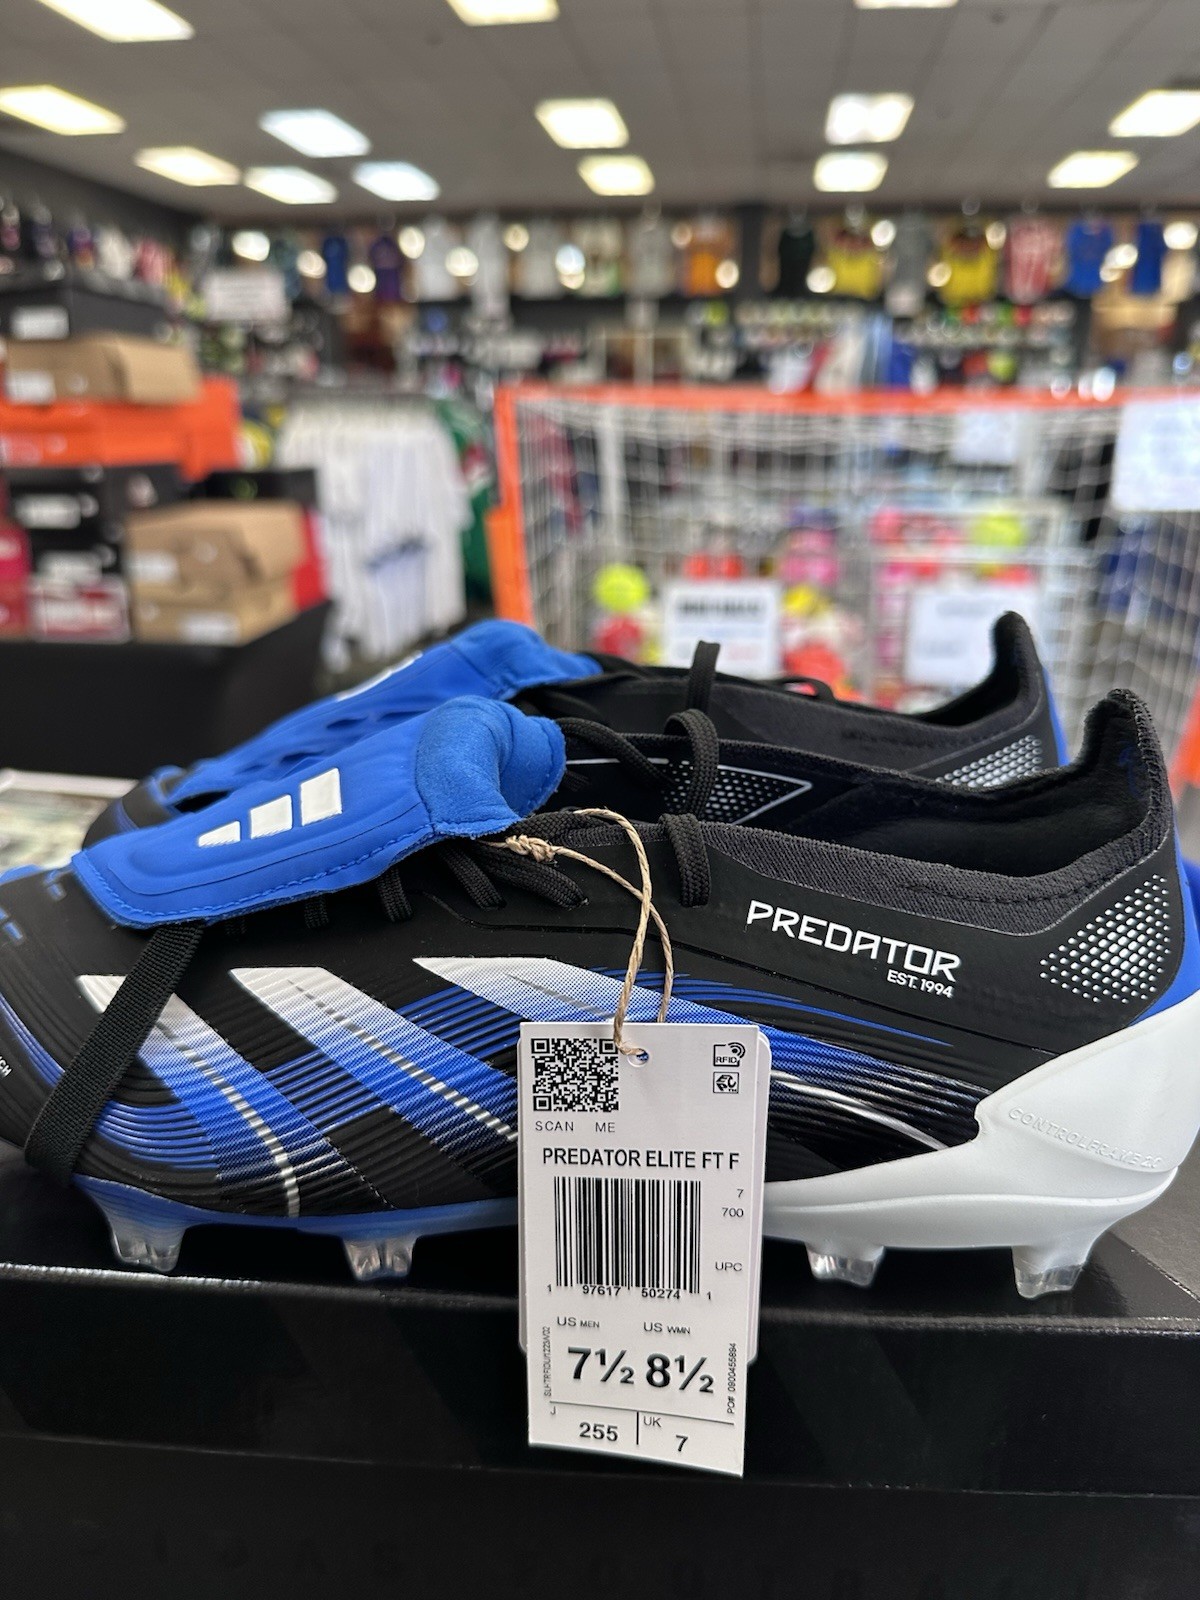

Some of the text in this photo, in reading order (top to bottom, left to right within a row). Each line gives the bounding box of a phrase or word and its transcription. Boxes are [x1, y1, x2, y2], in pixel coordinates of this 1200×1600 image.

[745, 899, 962, 984] PREDATOR
[886, 969, 954, 999] EST. 1994
[534, 1120, 616, 1133] SCAN ME
[542, 1147, 740, 1170] PREDATOR ELITE FT F
[736, 1189, 744, 1198] 7
[721, 1208, 744, 1218] 700
[715, 1262, 743, 1272] UPC
[582, 1285, 621, 1297] 97617
[641, 1288, 681, 1300] 50274
[557, 1316, 600, 1328] US MEN
[643, 1322, 691, 1335] US WMN
[727, 1395, 736, 1414] PO#
[643, 1416, 662, 1427] UK
[579, 1422, 619, 1442] 255
[675, 1435, 689, 1452] 7
